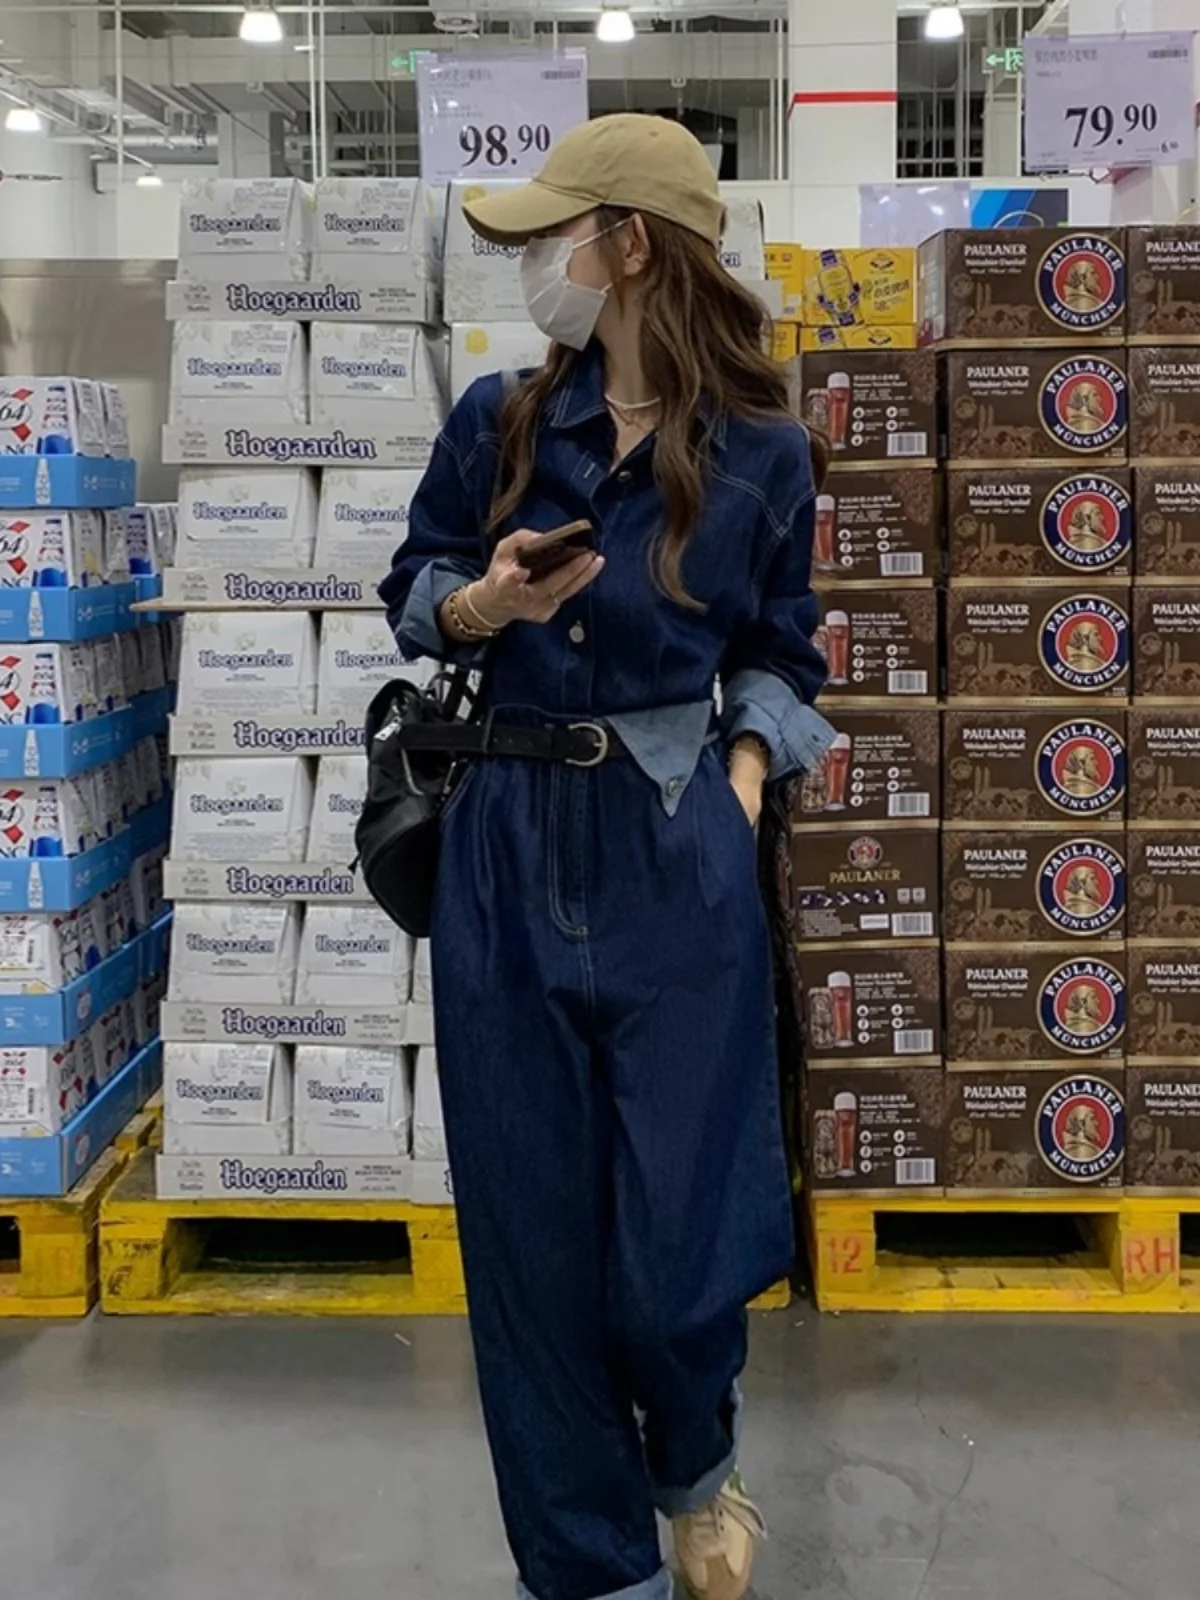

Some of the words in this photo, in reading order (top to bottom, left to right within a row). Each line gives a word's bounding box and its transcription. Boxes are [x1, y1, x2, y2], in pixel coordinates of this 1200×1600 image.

[1065, 104, 1157, 148] 79.90
[459, 124, 551, 167] 98.90
[190, 214, 280, 235] Hoegaarden
[324, 213, 405, 233] Hoegaarden
[964, 244, 1027, 255] PAULANER
[1044, 238, 1124, 272] PAULANER
[226, 283, 362, 316] Hoegaarden
[1050, 301, 1118, 325] MÜNCHEN
[187, 357, 281, 377] Hoegaarden
[321, 356, 406, 377] Hoegaarden
[967, 366, 1030, 378] PAULANER
[1047, 361, 1125, 393] PAULANER
[225, 429, 377, 460] Hoegaarden
[1052, 423, 1119, 447] MÜNCHEN
[968, 485, 1031, 496] PAULANER
[1049, 479, 1128, 512] PAULANER
[192, 502, 287, 521] Hoegaarden
[1054, 542, 1121, 565] MÜNCHEN
[225, 573, 362, 604] Hoegaarden
[966, 604, 1029, 616] PAULANER
[1046, 600, 1127, 633] PAULANER
[198, 650, 292, 670] Hoegaarden
[1052, 663, 1121, 685] MÜNCHEN
[962, 728, 1026, 740] PAULANER
[1043, 725, 1122, 757] PAULANER
[190, 794, 283, 815] Hoegaarden
[1049, 787, 1117, 810] MÜNCHEN
[964, 849, 1028, 861] PAULANER
[1043, 844, 1122, 877] PAULANER
[227, 867, 353, 897] Hoegaarden
[829, 870, 901, 883] PAULANER
[1049, 906, 1117, 929] MÜNCHEN
[186, 933, 276, 955] Hoegaarden
[315, 934, 390, 955] Hoegaarden
[965, 968, 1029, 980] PAULANER
[1045, 964, 1123, 997] PAULANER
[221, 1007, 346, 1038] Hoegaarden
[1050, 1025, 1117, 1047] MÜNCHEN
[176, 1079, 263, 1102] Hoegaarden
[307, 1080, 384, 1103] Hoegaarden
[963, 1086, 1027, 1098] PAULANER
[1043, 1081, 1122, 1117] PAULANER
[1049, 1151, 1116, 1175] MÜNCHEN
[220, 1159, 348, 1193] Hoegaarden
